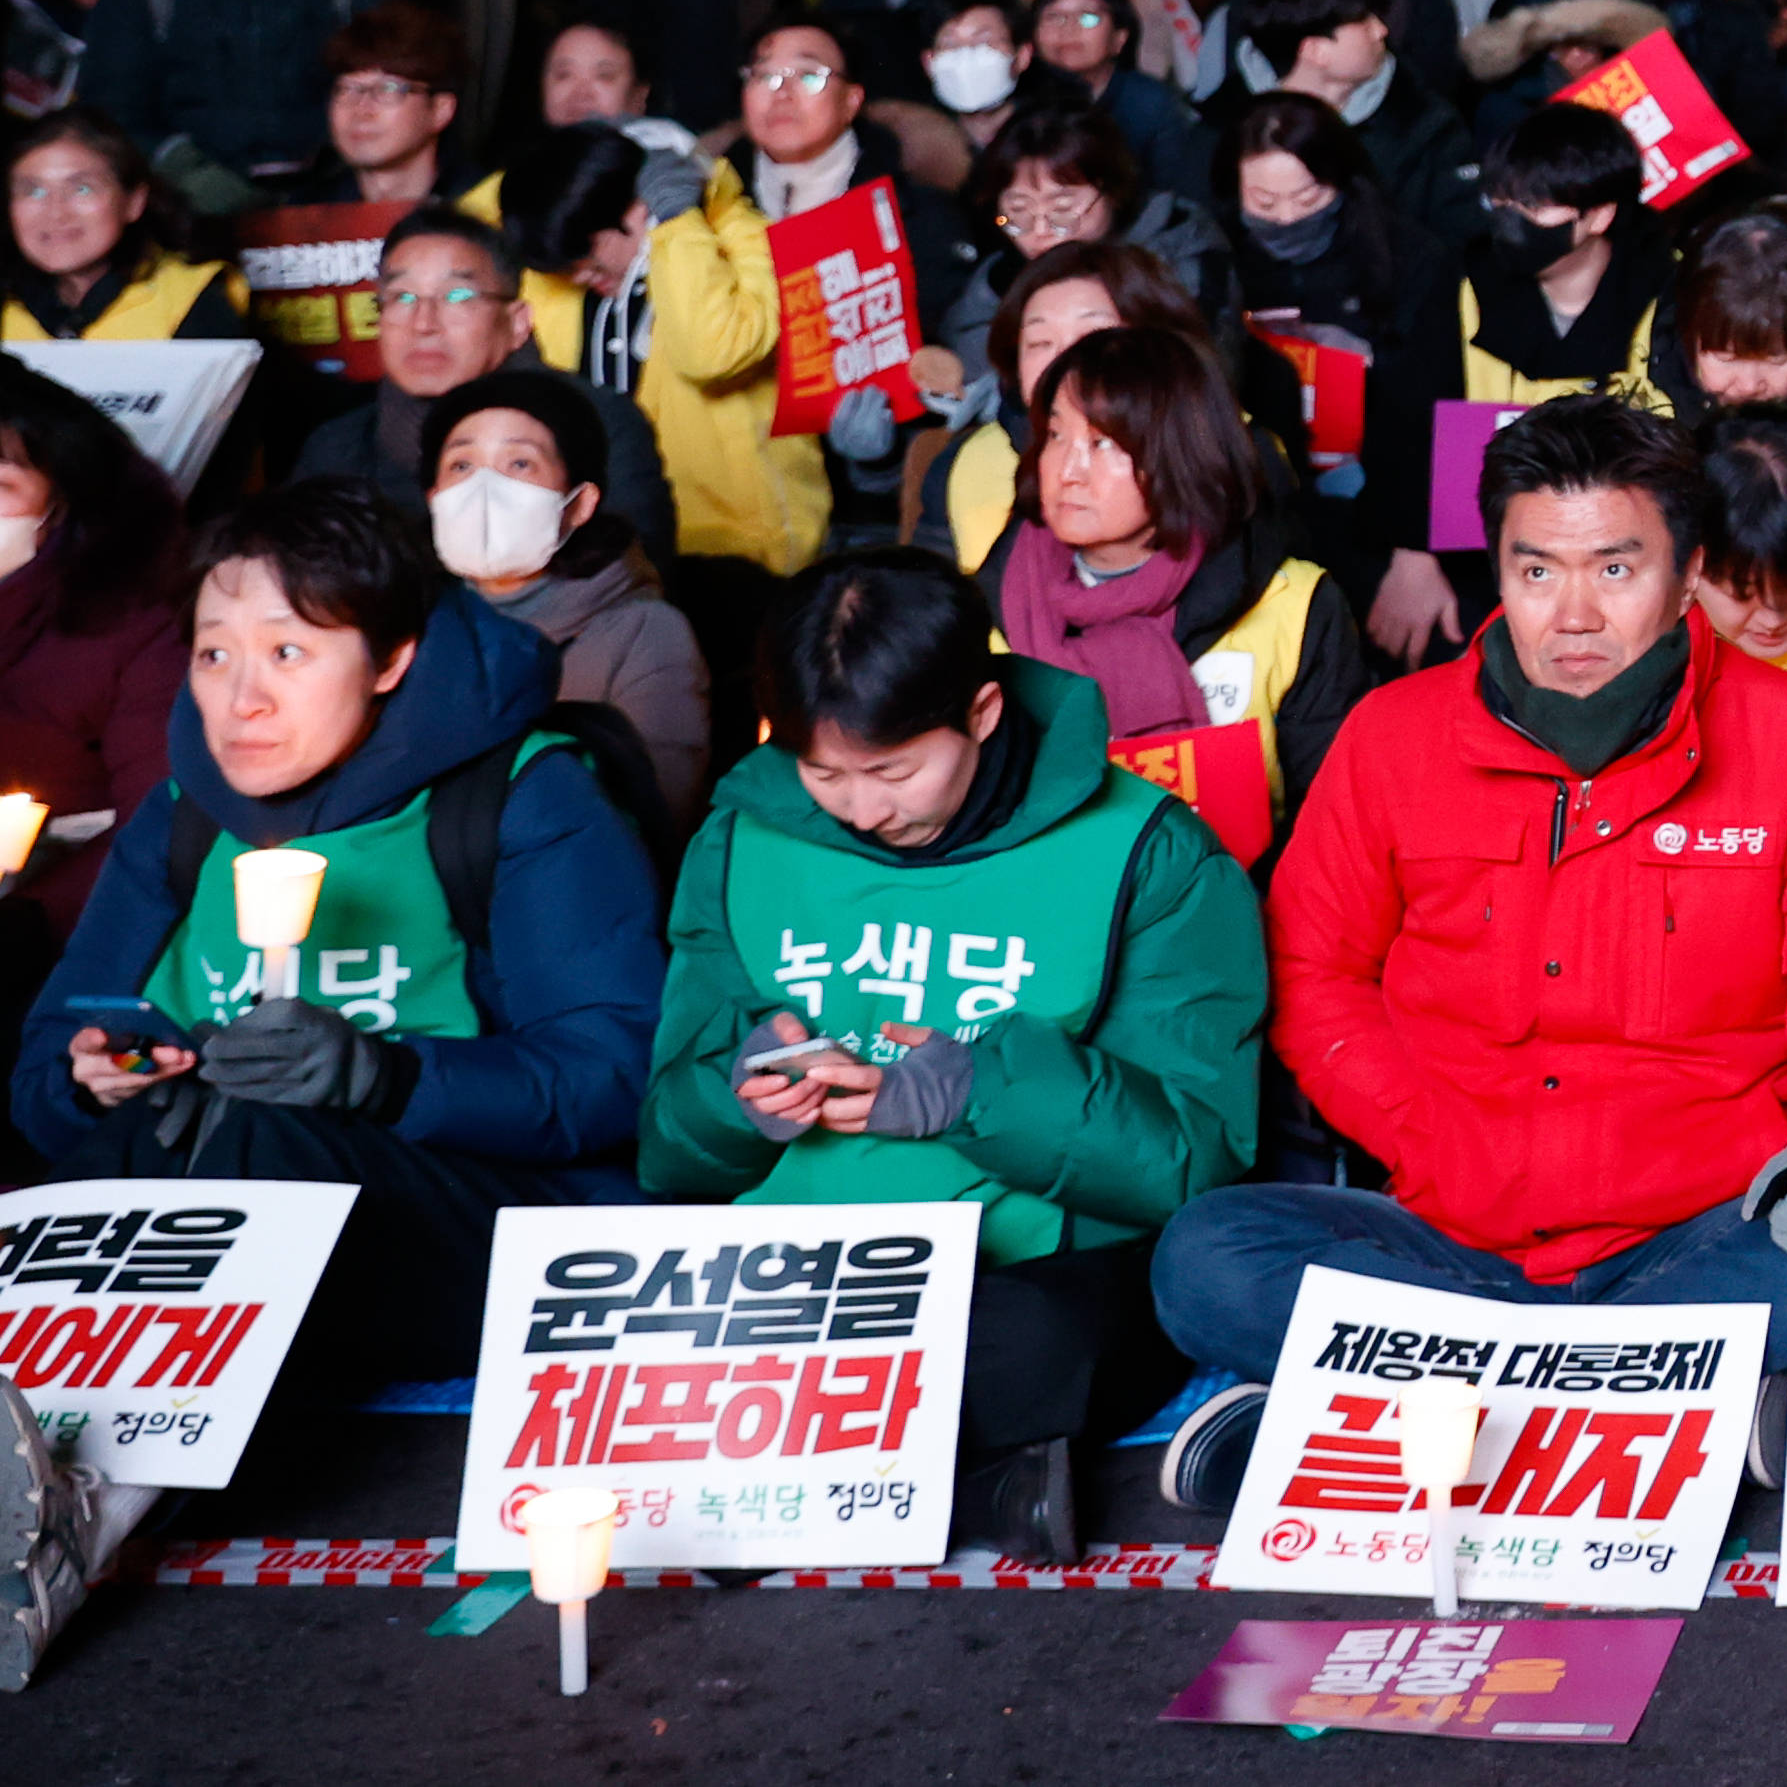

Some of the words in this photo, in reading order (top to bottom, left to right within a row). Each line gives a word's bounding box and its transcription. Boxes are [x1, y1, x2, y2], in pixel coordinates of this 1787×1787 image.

[1203, 684, 1238, 707] 의당
[1693, 826, 1767, 854] 노동당
[773, 922, 1036, 1023] 녹색당
[524, 1235, 934, 1354] 윤석열을
[1314, 1321, 1499, 1382] 제왕적
[1495, 1339, 1727, 1392] 대통령제
[113, 1410, 214, 1445] 정의당
[504, 1350, 924, 1469] 체포하라
[612, 1487, 677, 1526] 동당
[696, 1483, 808, 1523] 녹색당
[828, 1481, 918, 1521] 정의당
[1454, 1534, 1562, 1567] 녹색당
[1583, 1540, 1678, 1574] 정의당
[1329, 1624, 1504, 1661] 퇴진
[1309, 1658, 1566, 1695] 광장을
